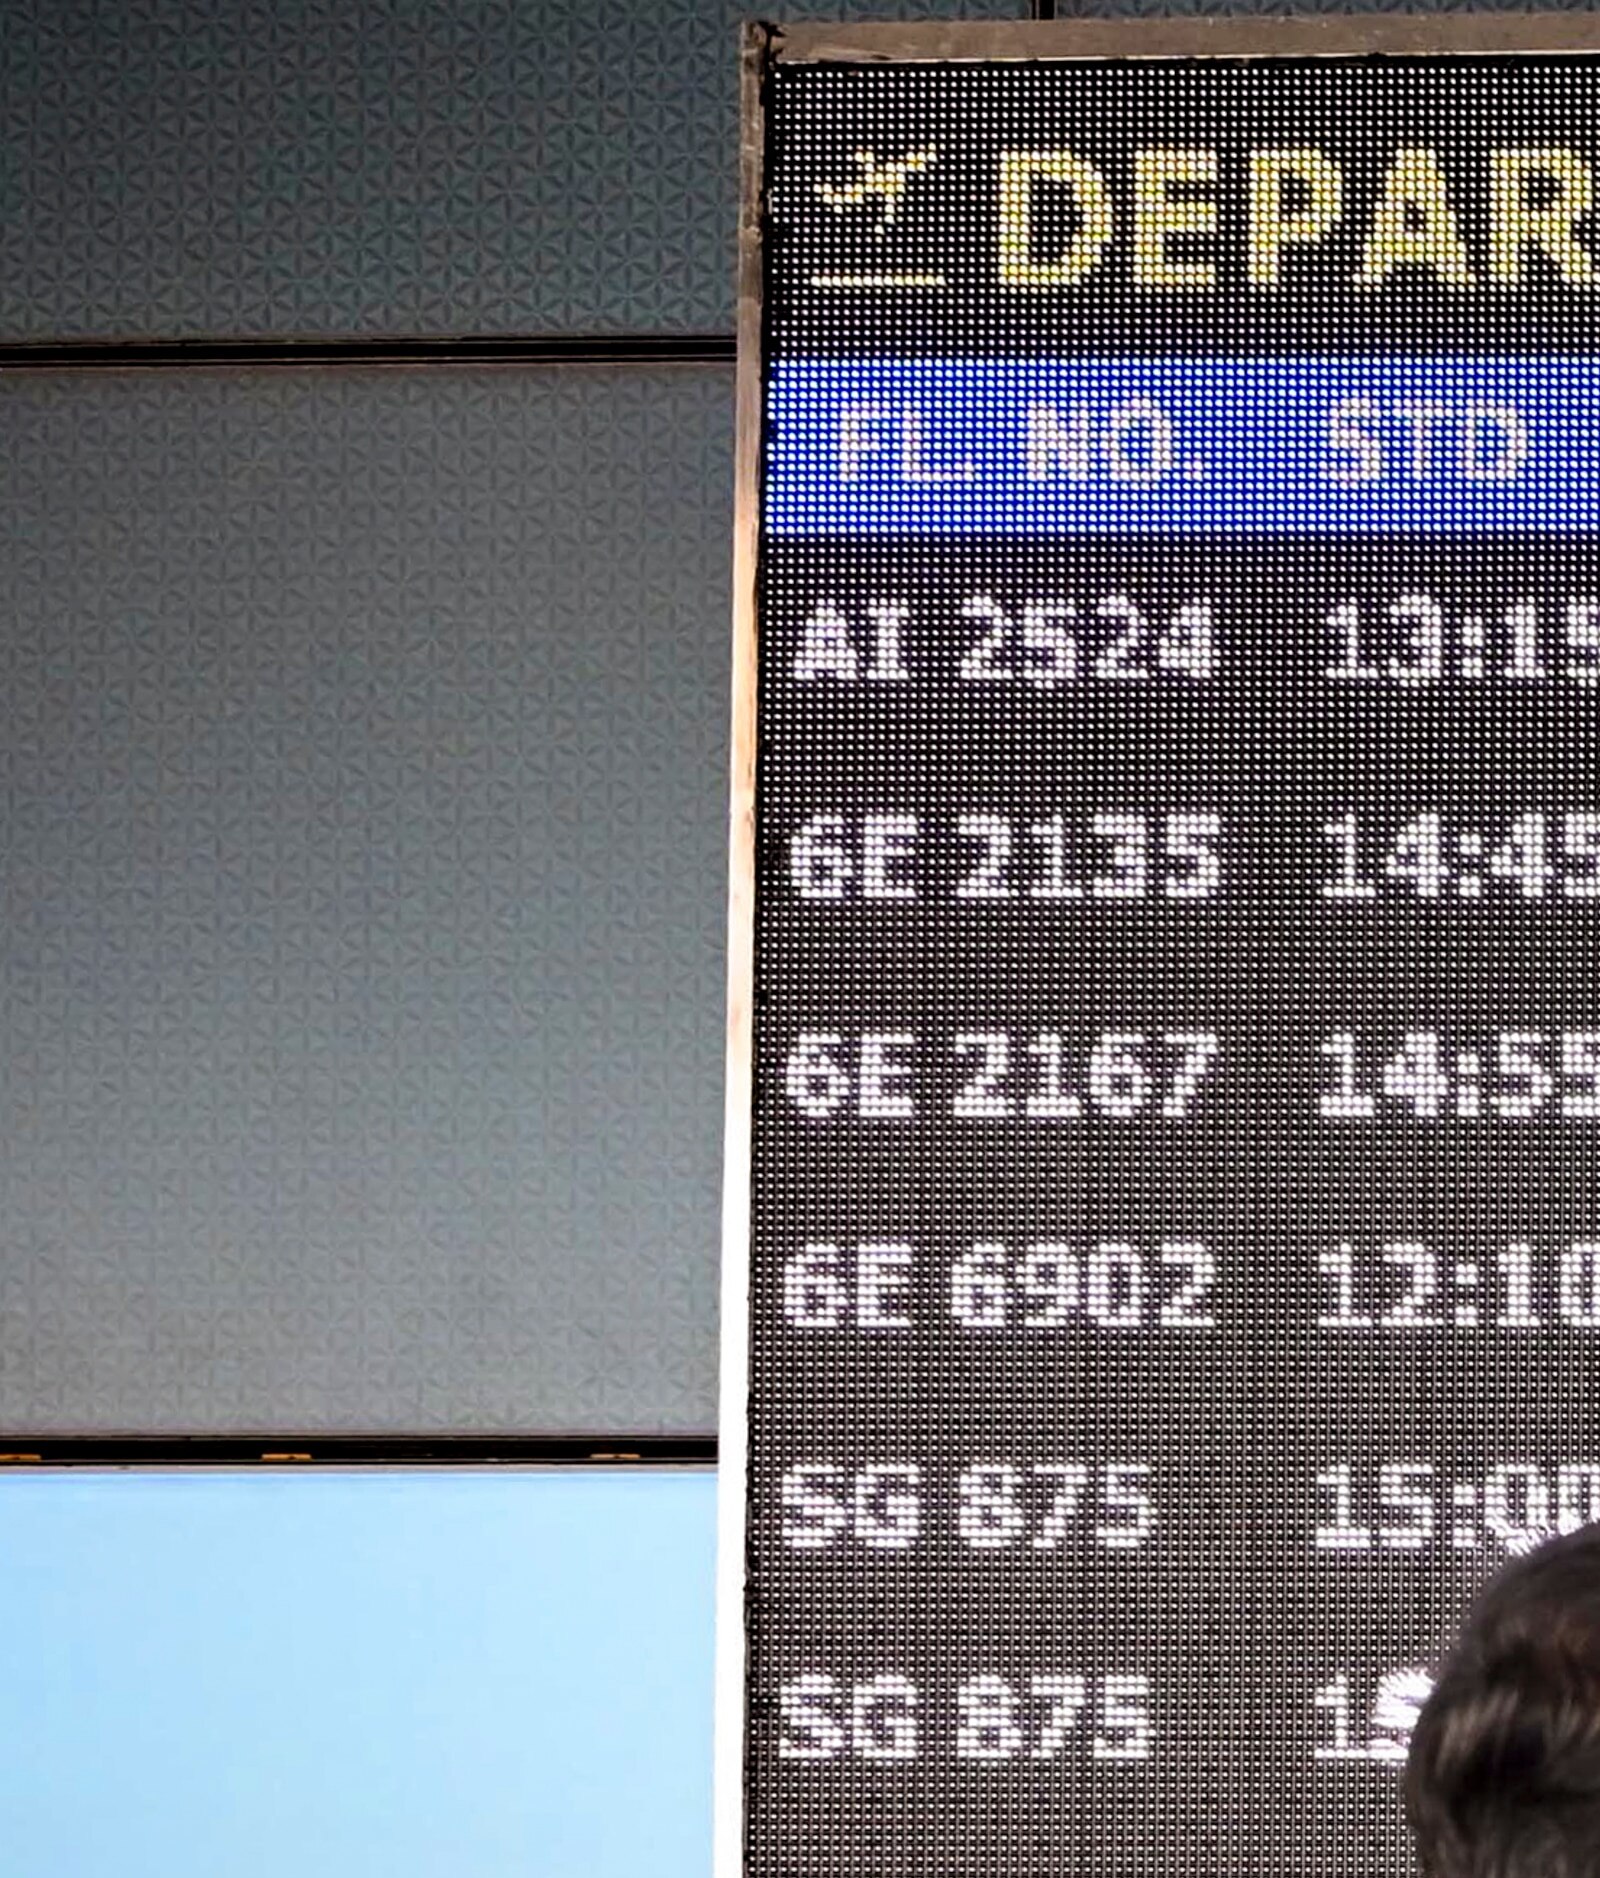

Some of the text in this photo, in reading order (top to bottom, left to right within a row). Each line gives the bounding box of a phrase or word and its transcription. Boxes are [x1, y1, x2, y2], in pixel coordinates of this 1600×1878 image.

[1325, 395, 1528, 486] STD
[793, 596, 909, 681] AI
[959, 594, 1222, 690] 2524
[789, 811, 916, 900] 6E
[955, 810, 1222, 900] 2135
[784, 1031, 912, 1119] 6E
[950, 1030, 1219, 1119] 2167
[781, 1241, 912, 1329] 6E
[948, 1240, 1217, 1329] 6902
[778, 1462, 915, 1550] SG
[957, 1462, 1155, 1550] 875
[777, 1672, 915, 1762] SG
[956, 1672, 1155, 1762] 875
